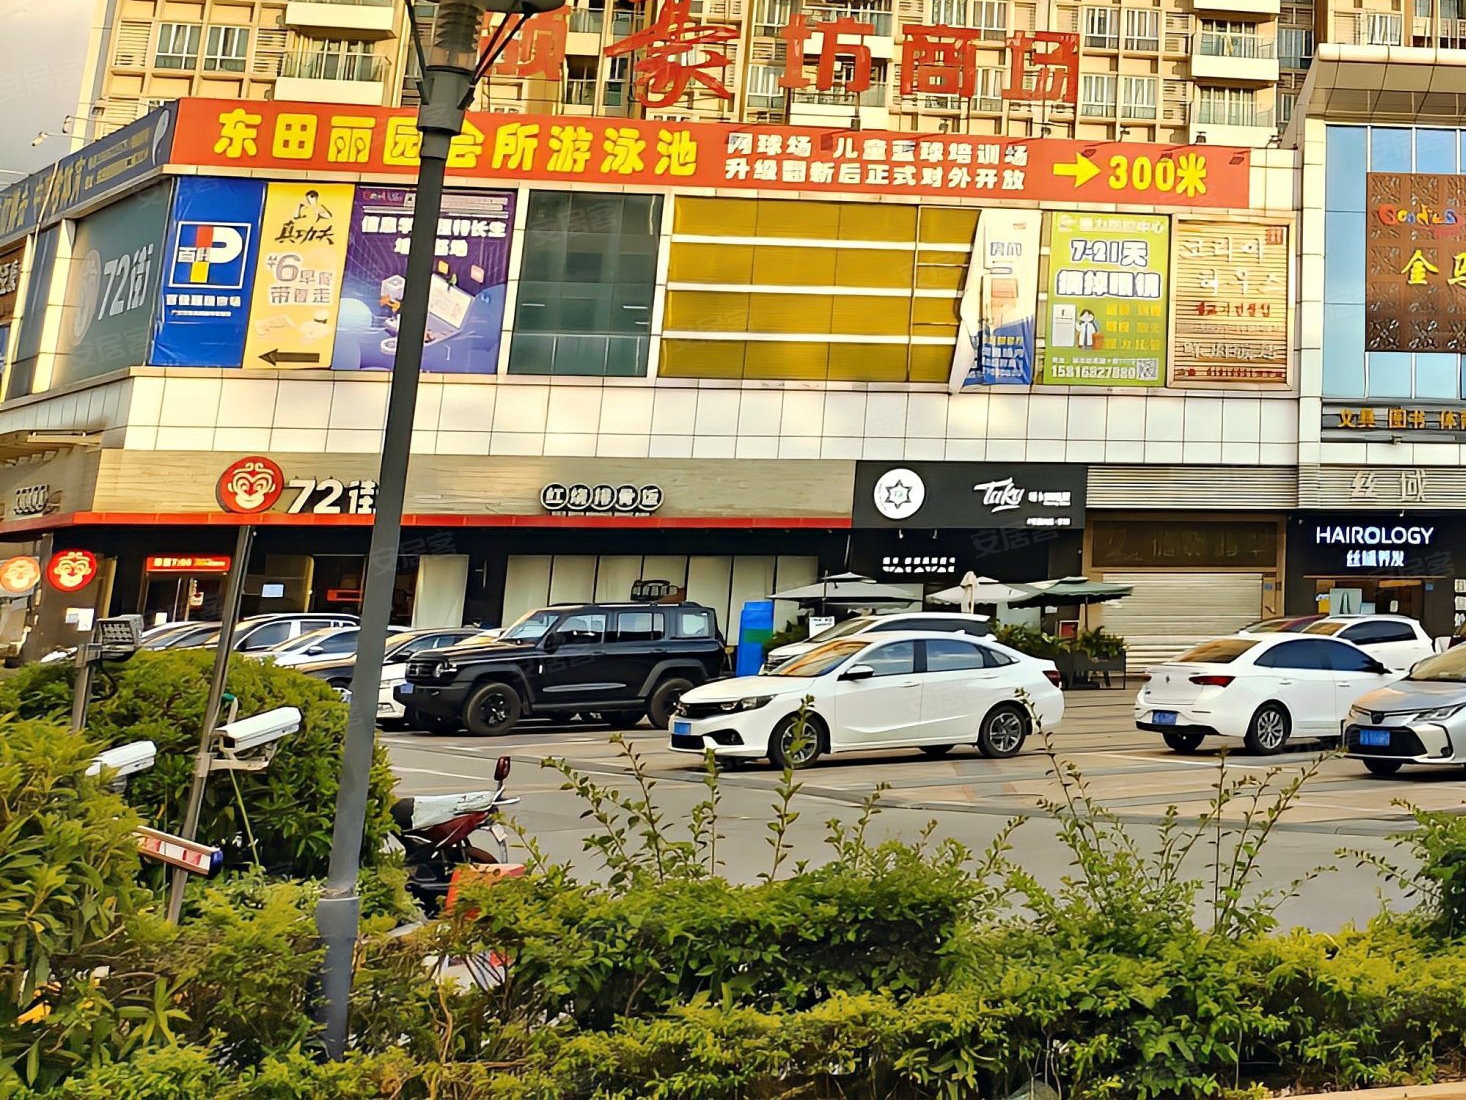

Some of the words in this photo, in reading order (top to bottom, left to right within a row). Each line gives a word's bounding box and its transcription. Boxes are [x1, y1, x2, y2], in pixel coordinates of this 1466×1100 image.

[213, 108, 699, 178] 东田丽园会所游泳池
[726, 132, 813, 159] 网球场
[724, 158, 1027, 191] 升级翻新后正式对外开放
[1107, 153, 1208, 199] 300米
[274, 220, 335, 245] 真功夫
[1178, 236, 1265, 265] 코리아
[98, 243, 154, 320] 72街
[1338, 408, 1376, 428] 文具
[1388, 408, 1426, 429] 图书
[287, 478, 380, 515] 72街
[1315, 525, 1435, 545] HAIROLOGY
